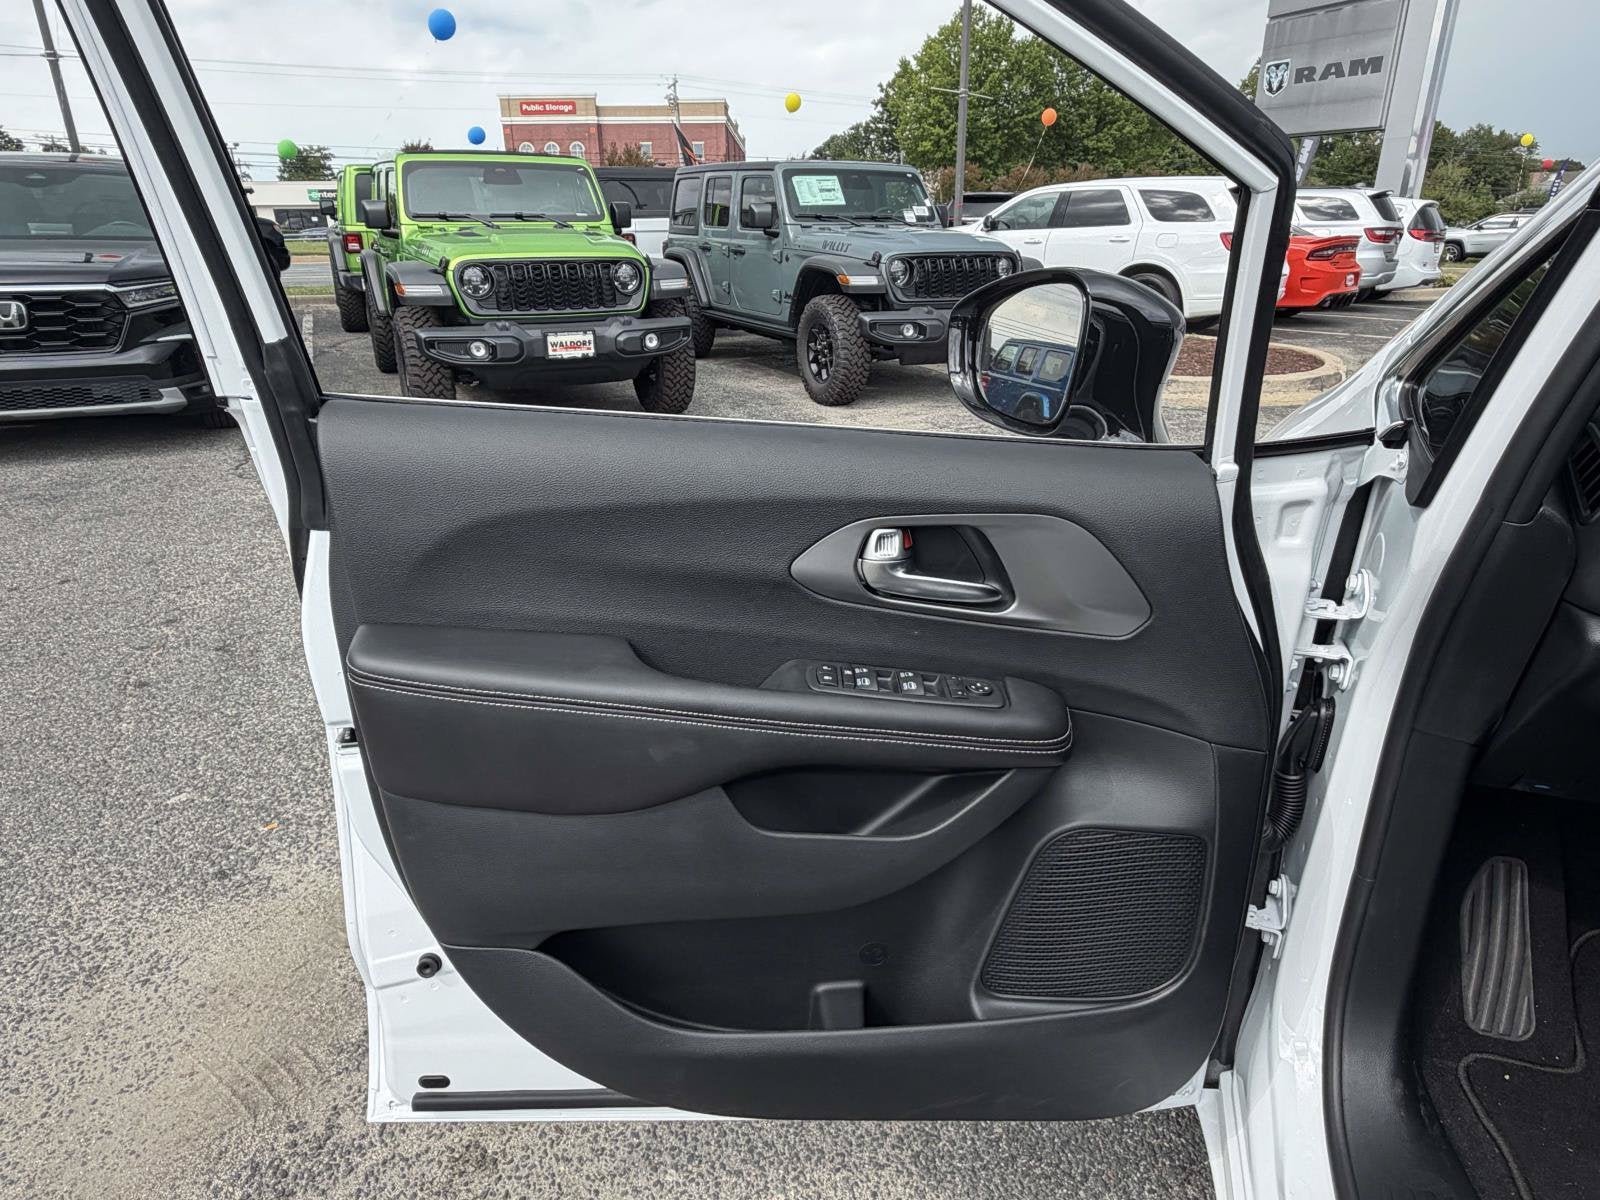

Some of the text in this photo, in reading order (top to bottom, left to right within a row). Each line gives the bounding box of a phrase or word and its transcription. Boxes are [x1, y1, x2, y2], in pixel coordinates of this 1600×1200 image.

[1294, 56, 1384, 85] RAM
[522, 104, 573, 112] Public Storage
[550, 340, 592, 348] WALDORF
